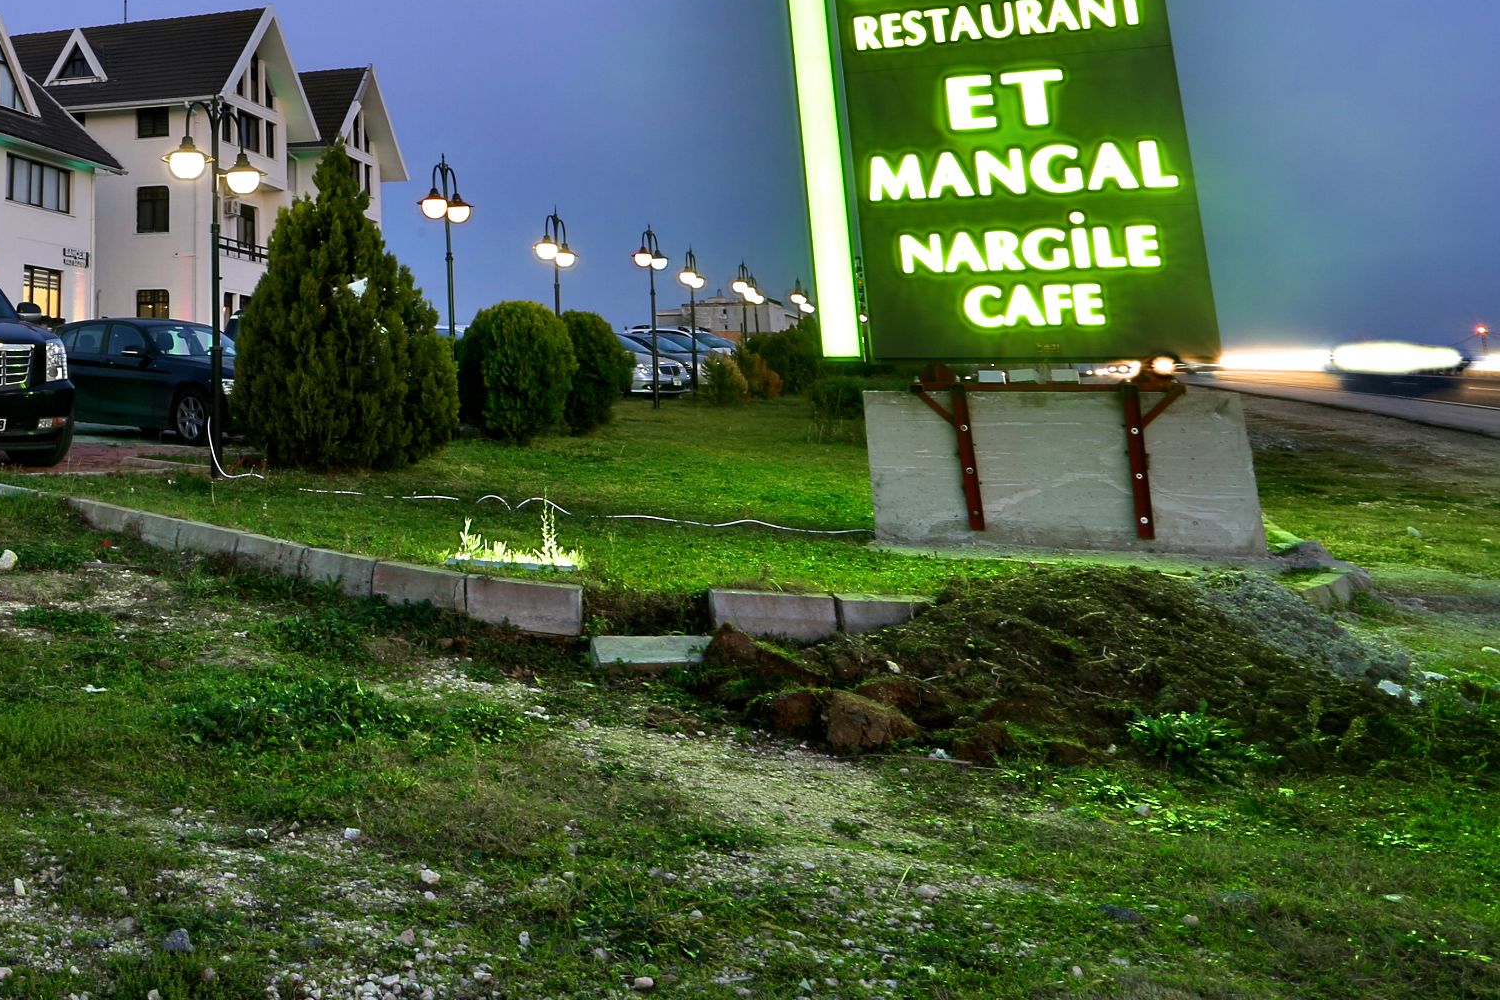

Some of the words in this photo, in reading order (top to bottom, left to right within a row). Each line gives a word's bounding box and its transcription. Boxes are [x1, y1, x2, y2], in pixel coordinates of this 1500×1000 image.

[945, 69, 1063, 130] ET
[869, 140, 1179, 202] MANGAL
[963, 283, 1106, 328] CAFE
